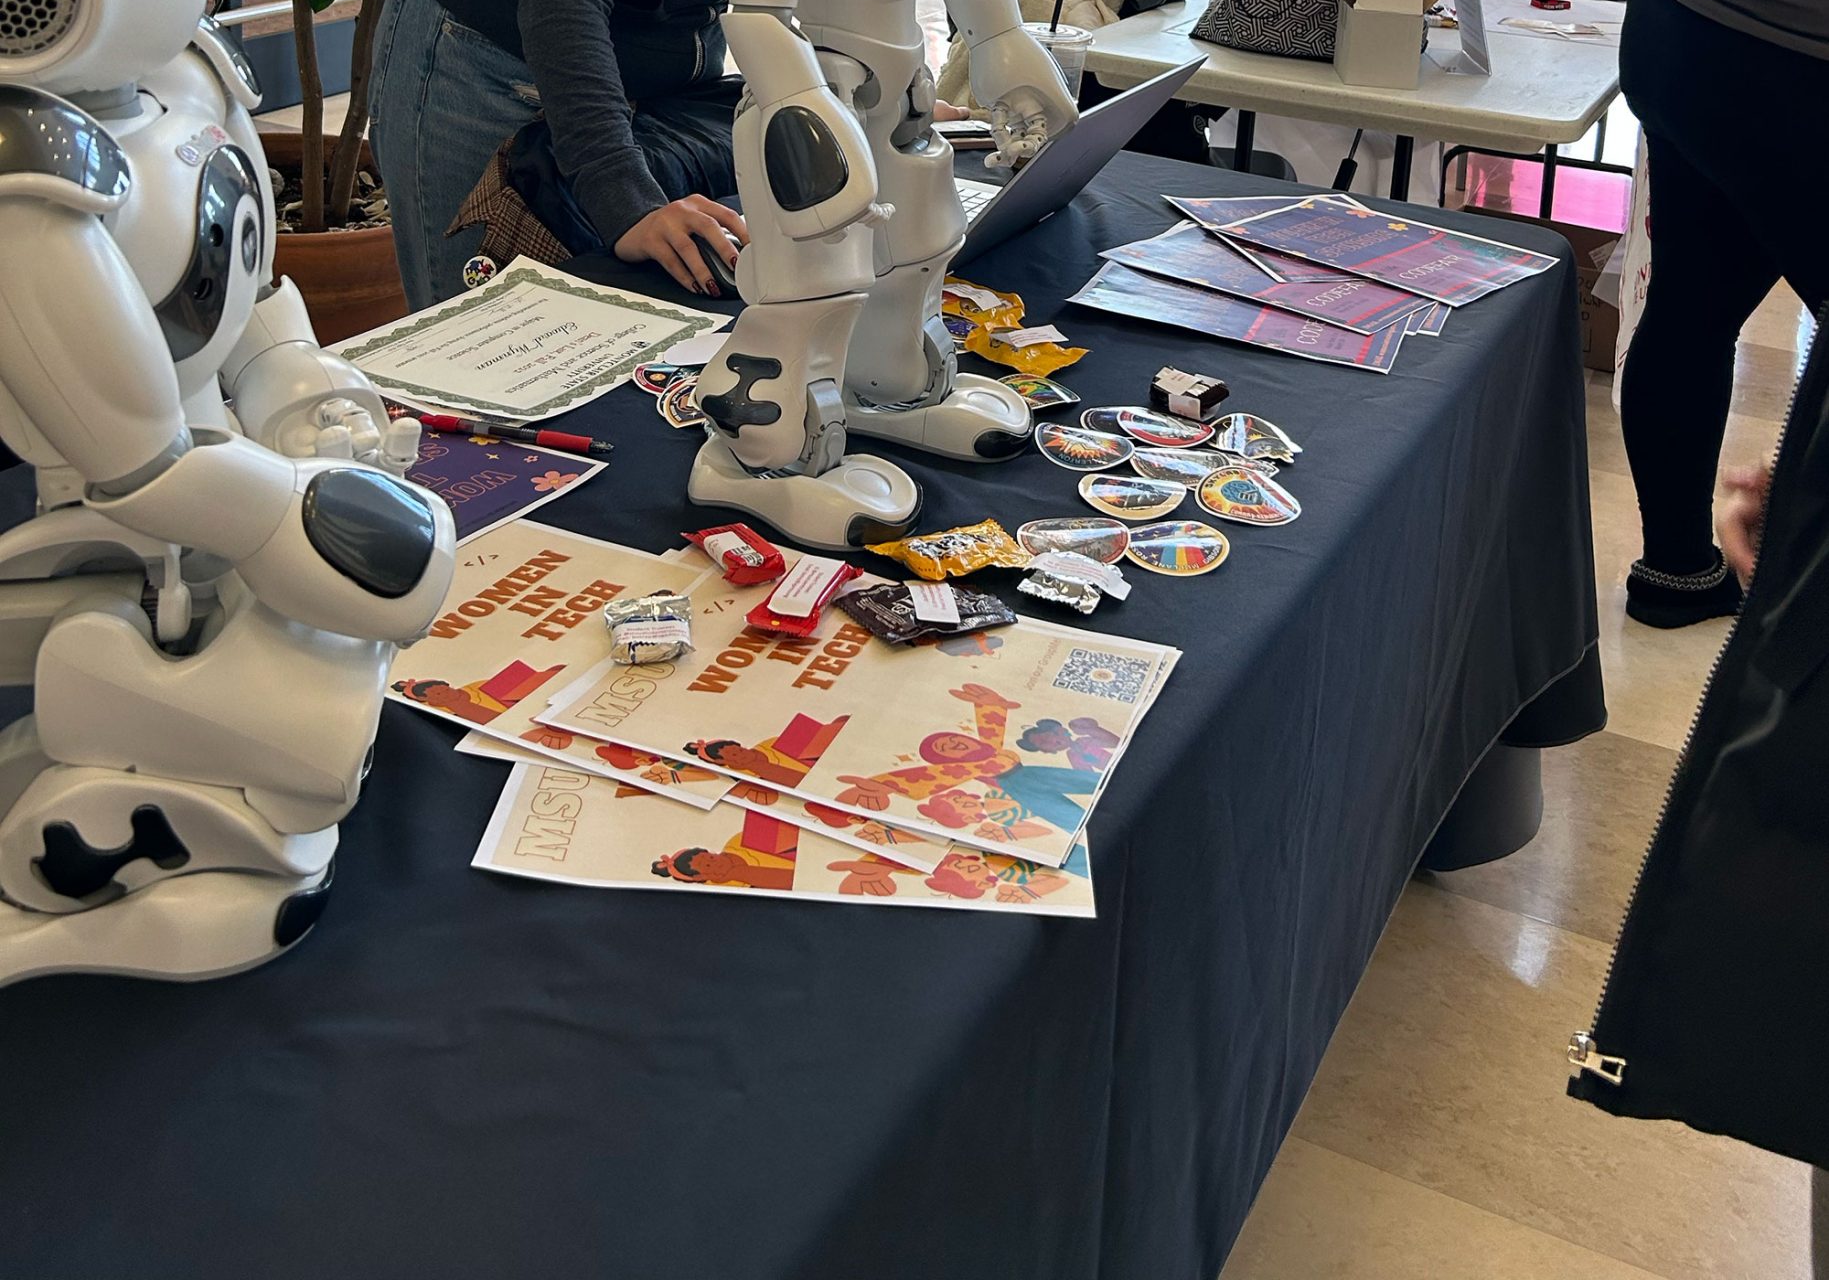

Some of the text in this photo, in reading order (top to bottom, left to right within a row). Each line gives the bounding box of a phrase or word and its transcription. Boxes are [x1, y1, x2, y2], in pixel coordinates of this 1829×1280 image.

[528, 322, 582, 346] Edward
[560, 349, 638, 388] MONTCLAIR STATE
[567, 354, 613, 376] UNIVERSITY
[428, 549, 573, 640] WOMEN
[508, 585, 569, 618] IN
[521, 579, 627, 642] TECH
[686, 625, 775, 694] WOM
[766, 632, 820, 666] IN
[791, 623, 873, 691] TECH
